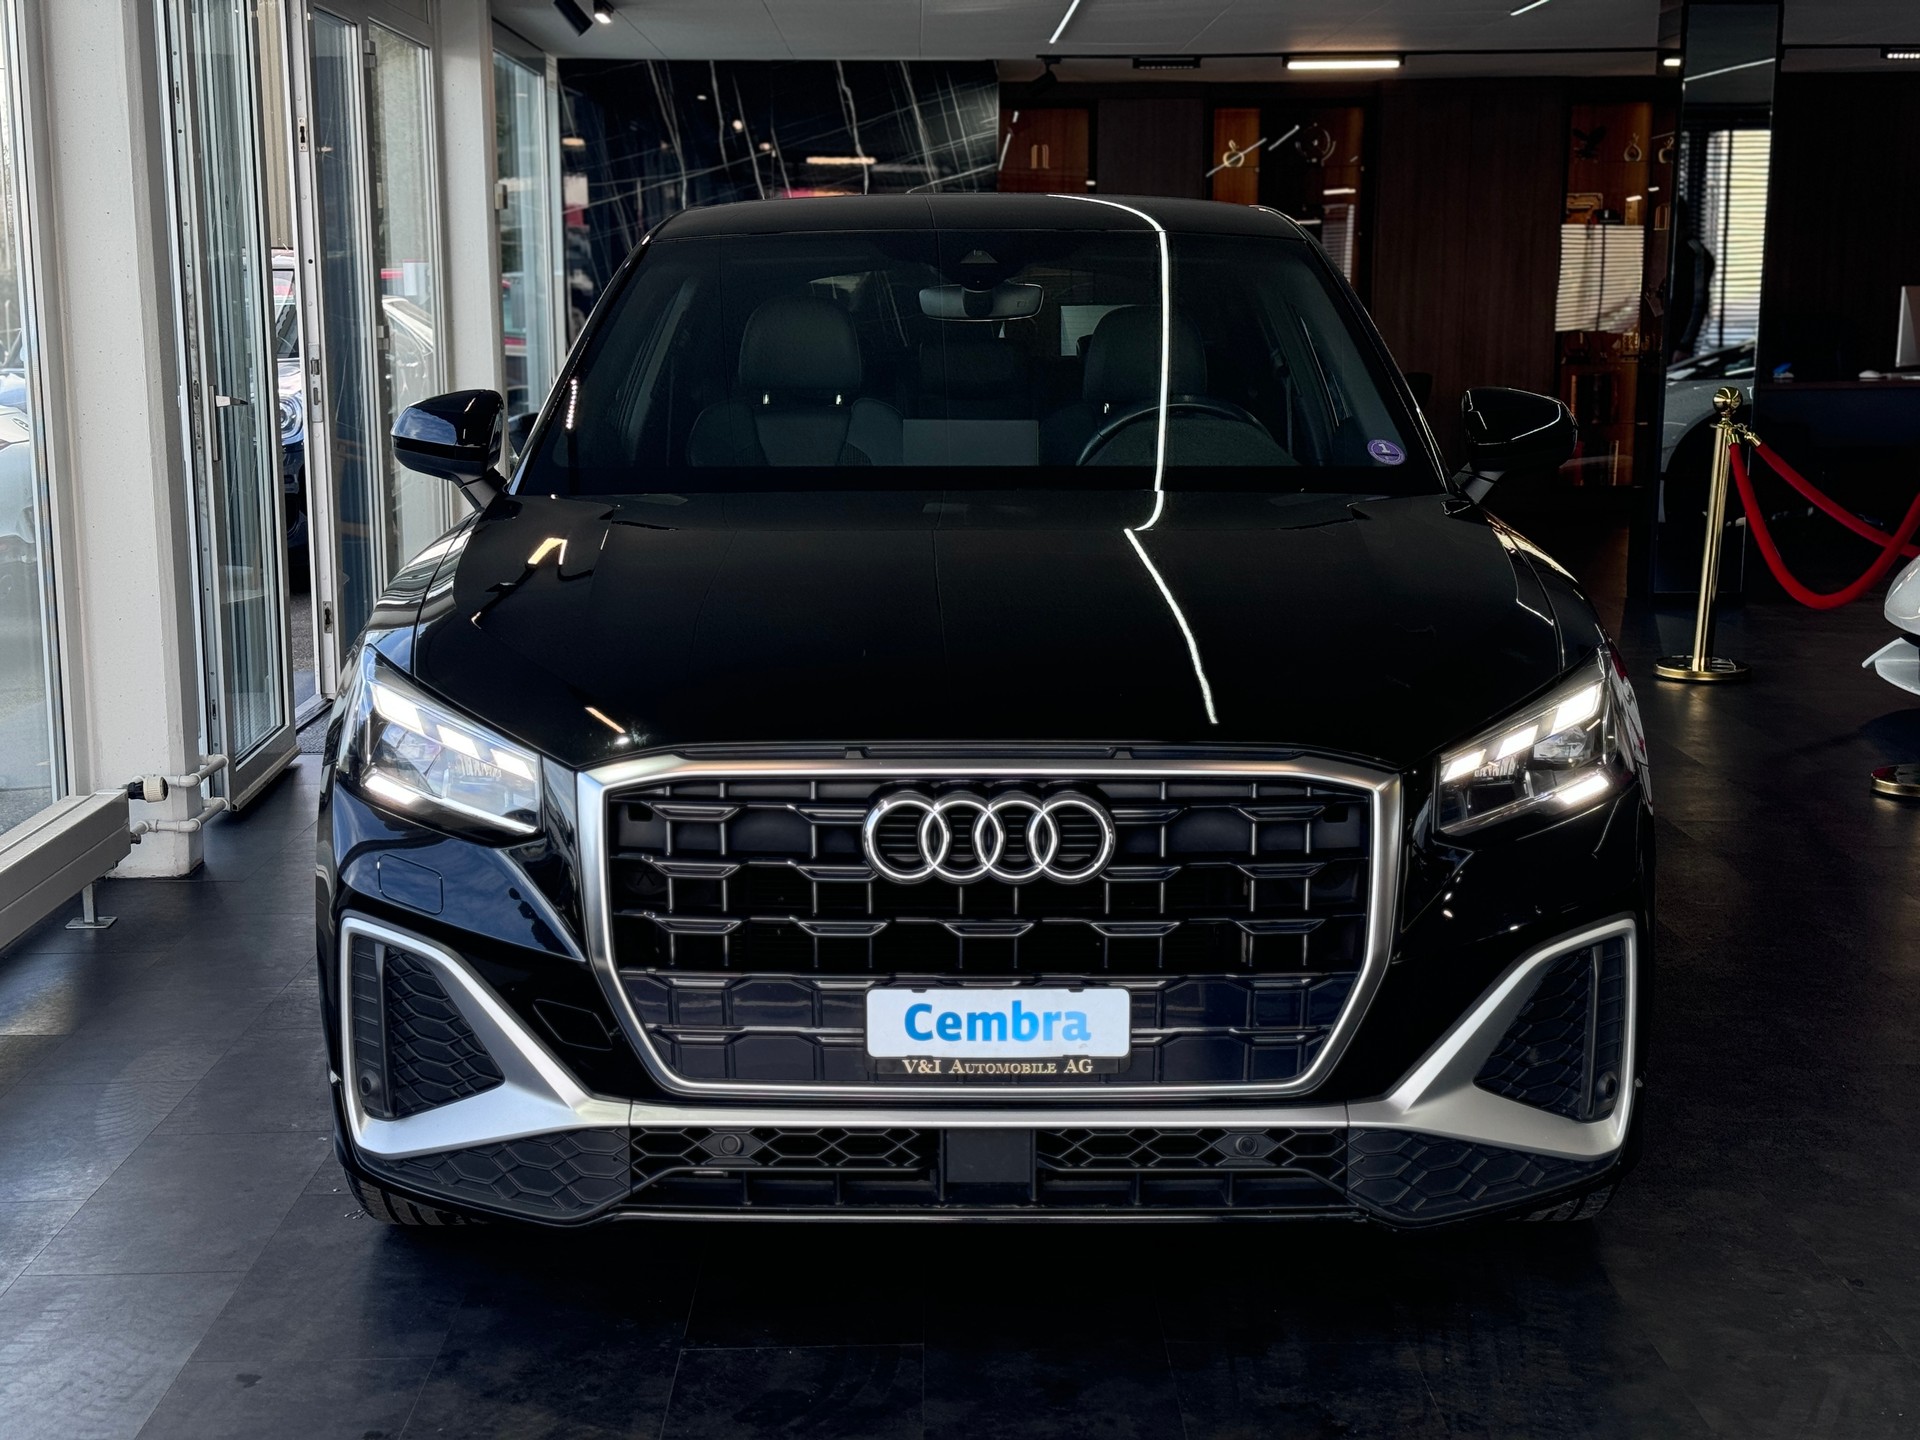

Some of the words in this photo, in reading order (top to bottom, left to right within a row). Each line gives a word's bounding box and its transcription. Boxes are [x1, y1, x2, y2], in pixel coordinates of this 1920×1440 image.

[904, 1000, 1091, 1042] Cembra
[902, 1059, 942, 1074] V&I
[1063, 1058, 1093, 1074] AG
